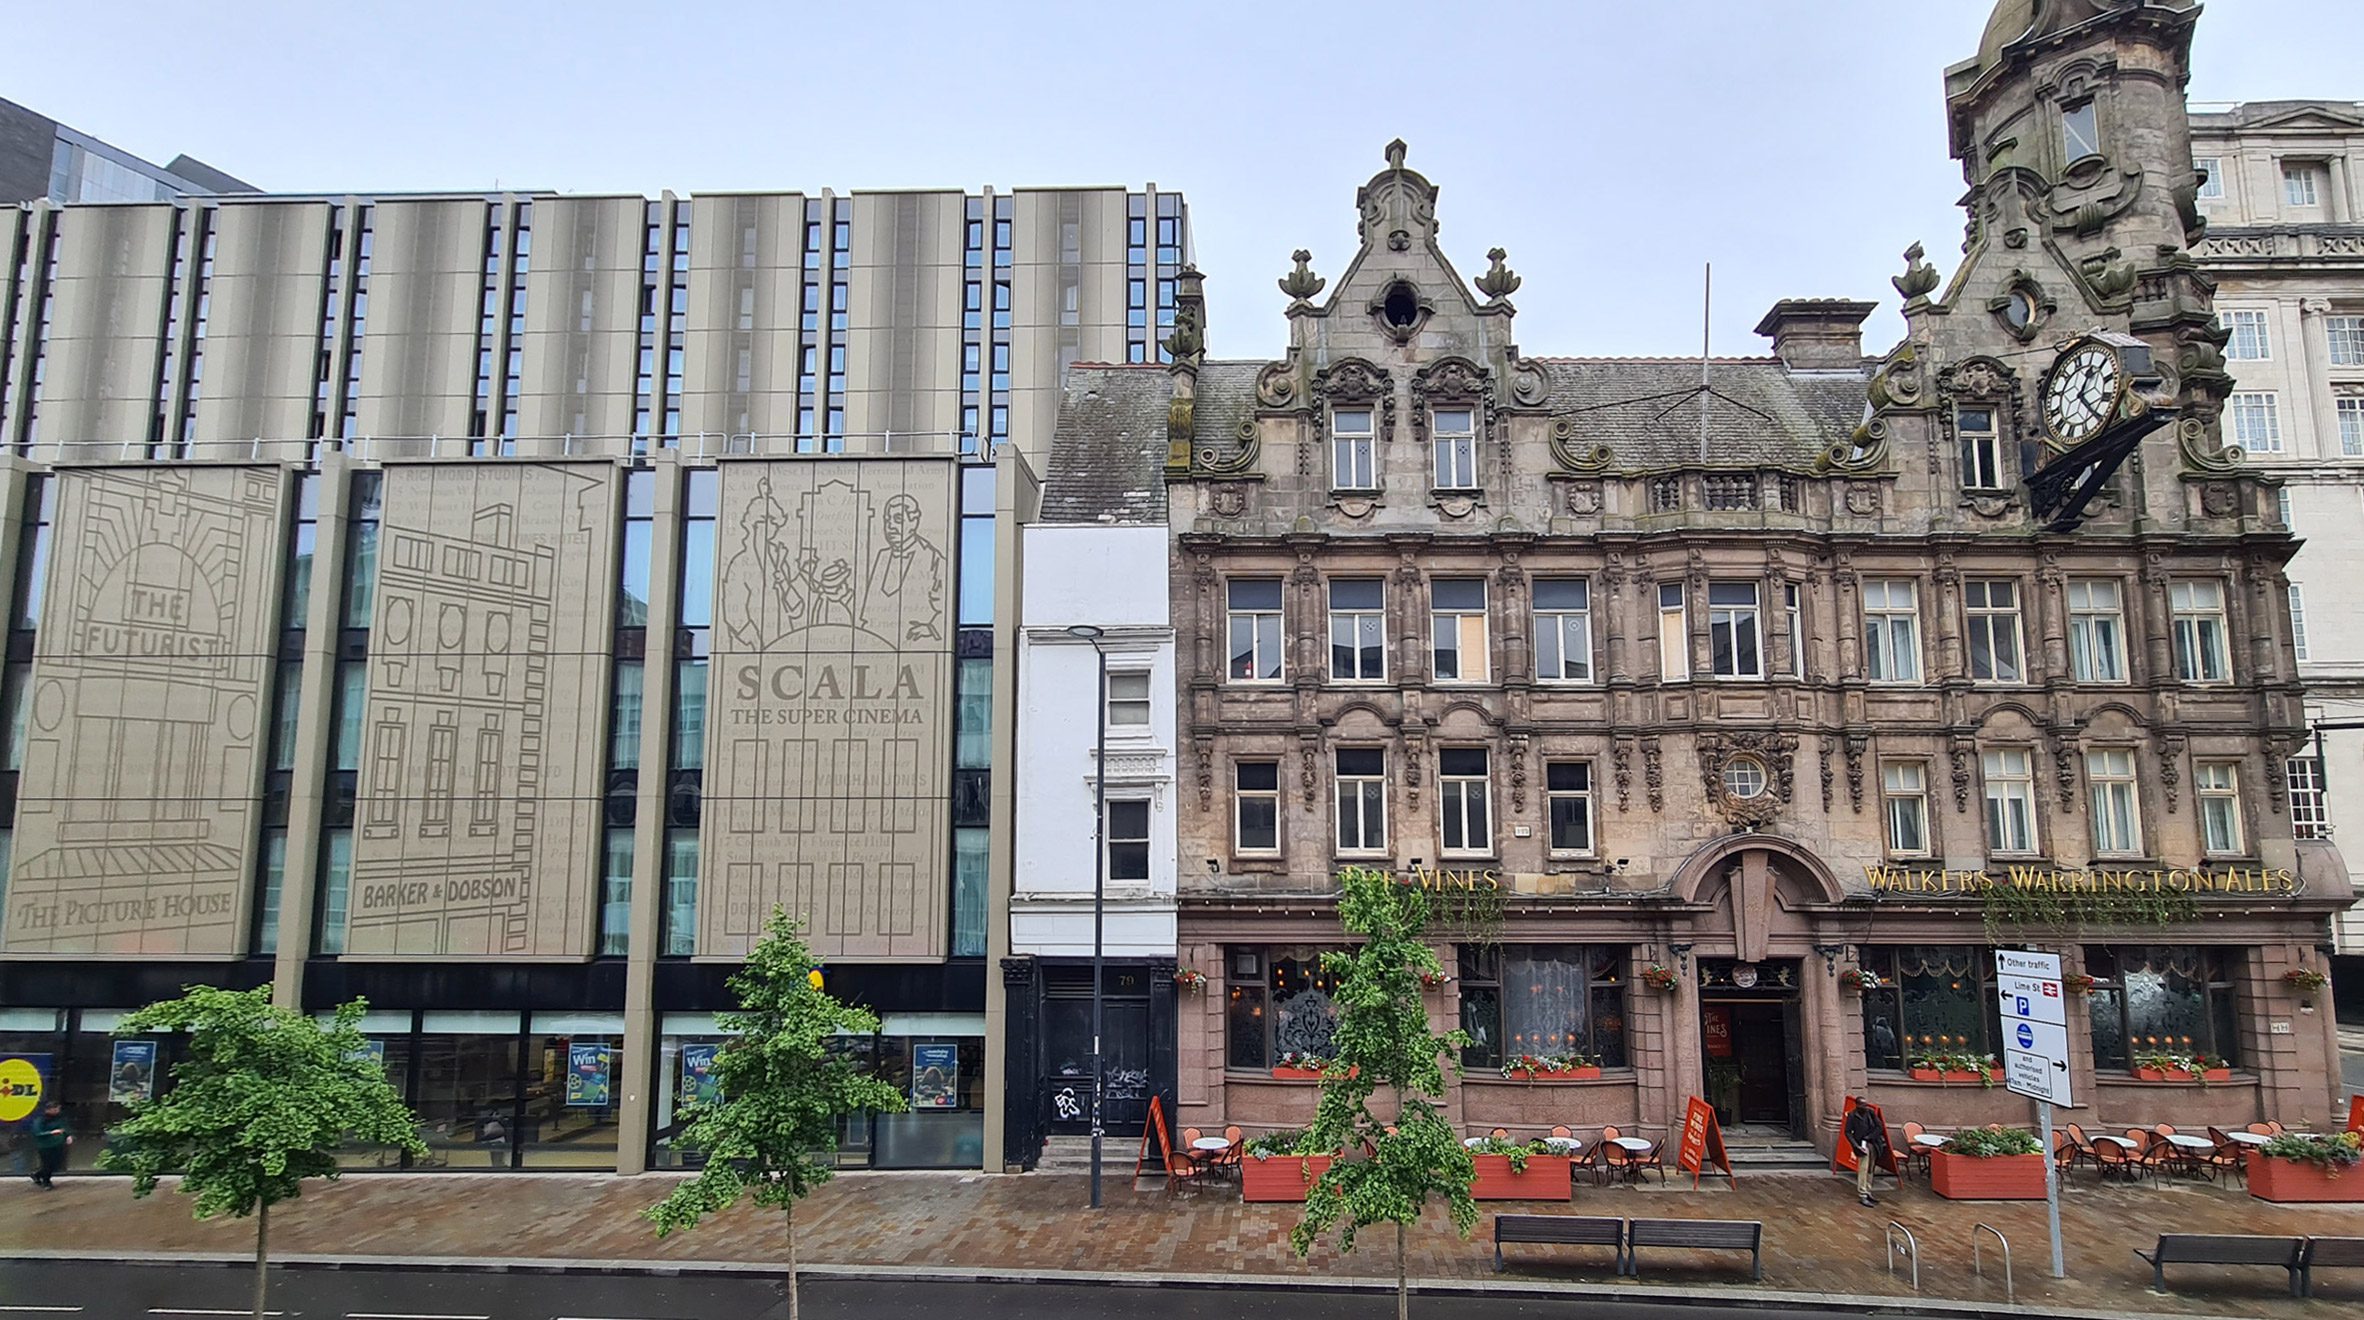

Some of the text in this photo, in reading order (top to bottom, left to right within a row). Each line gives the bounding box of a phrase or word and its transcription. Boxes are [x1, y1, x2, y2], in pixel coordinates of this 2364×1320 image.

[131, 588, 184, 621] THE
[86, 625, 219, 664] FUTURIST
[736, 664, 923, 701] SCALA
[731, 709, 923, 725] THE SUPER CINEMA
[1415, 863, 1498, 892] VINES
[1863, 864, 2293, 893] WALKERS WARRINGTON ALES
[363, 882, 428, 908] BARKER
[433, 884, 443, 898] &
[448, 877, 516, 902] DOBSON
[18, 891, 232, 929] THE PICTURE HOUSE
[2007, 958, 2050, 970] Other traffic
[2014, 981, 2041, 992] Lime St
[2019, 998, 2027, 1013] P
[573, 1053, 596, 1066] Win
[687, 1054, 711, 1067] Win
